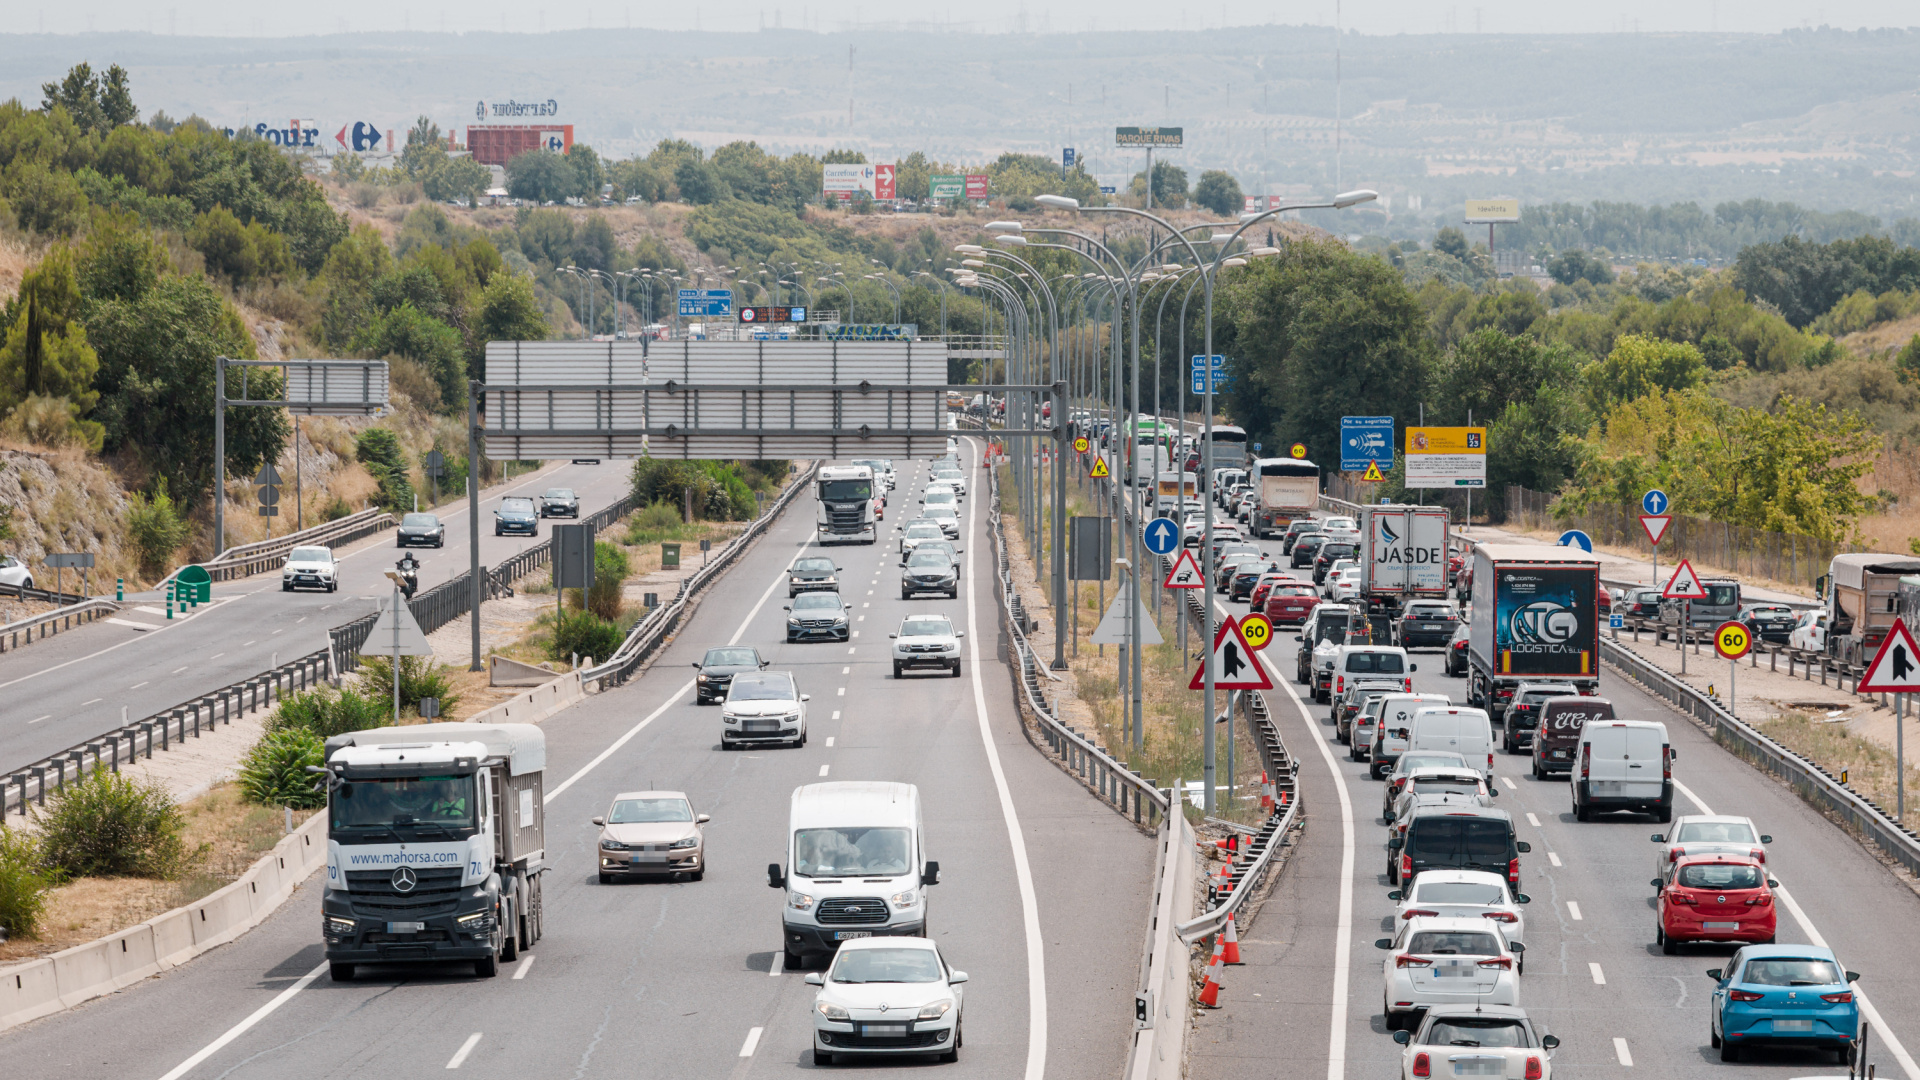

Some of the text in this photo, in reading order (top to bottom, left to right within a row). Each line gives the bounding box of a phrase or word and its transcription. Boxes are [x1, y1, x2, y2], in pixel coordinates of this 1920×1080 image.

[1116, 134, 1181, 144] PARQUE RIVAS
[825, 169, 858, 177] Carrefour
[1377, 547, 1441, 564] JASDE
[1245, 625, 1265, 638] 60
[1723, 634, 1743, 647] 60
[1511, 644, 1567, 654] LOGISTICA
[1555, 712, 1572, 729] El
[350, 850, 458, 865] www.mahorsa.com
[470, 861, 483, 876] 70
